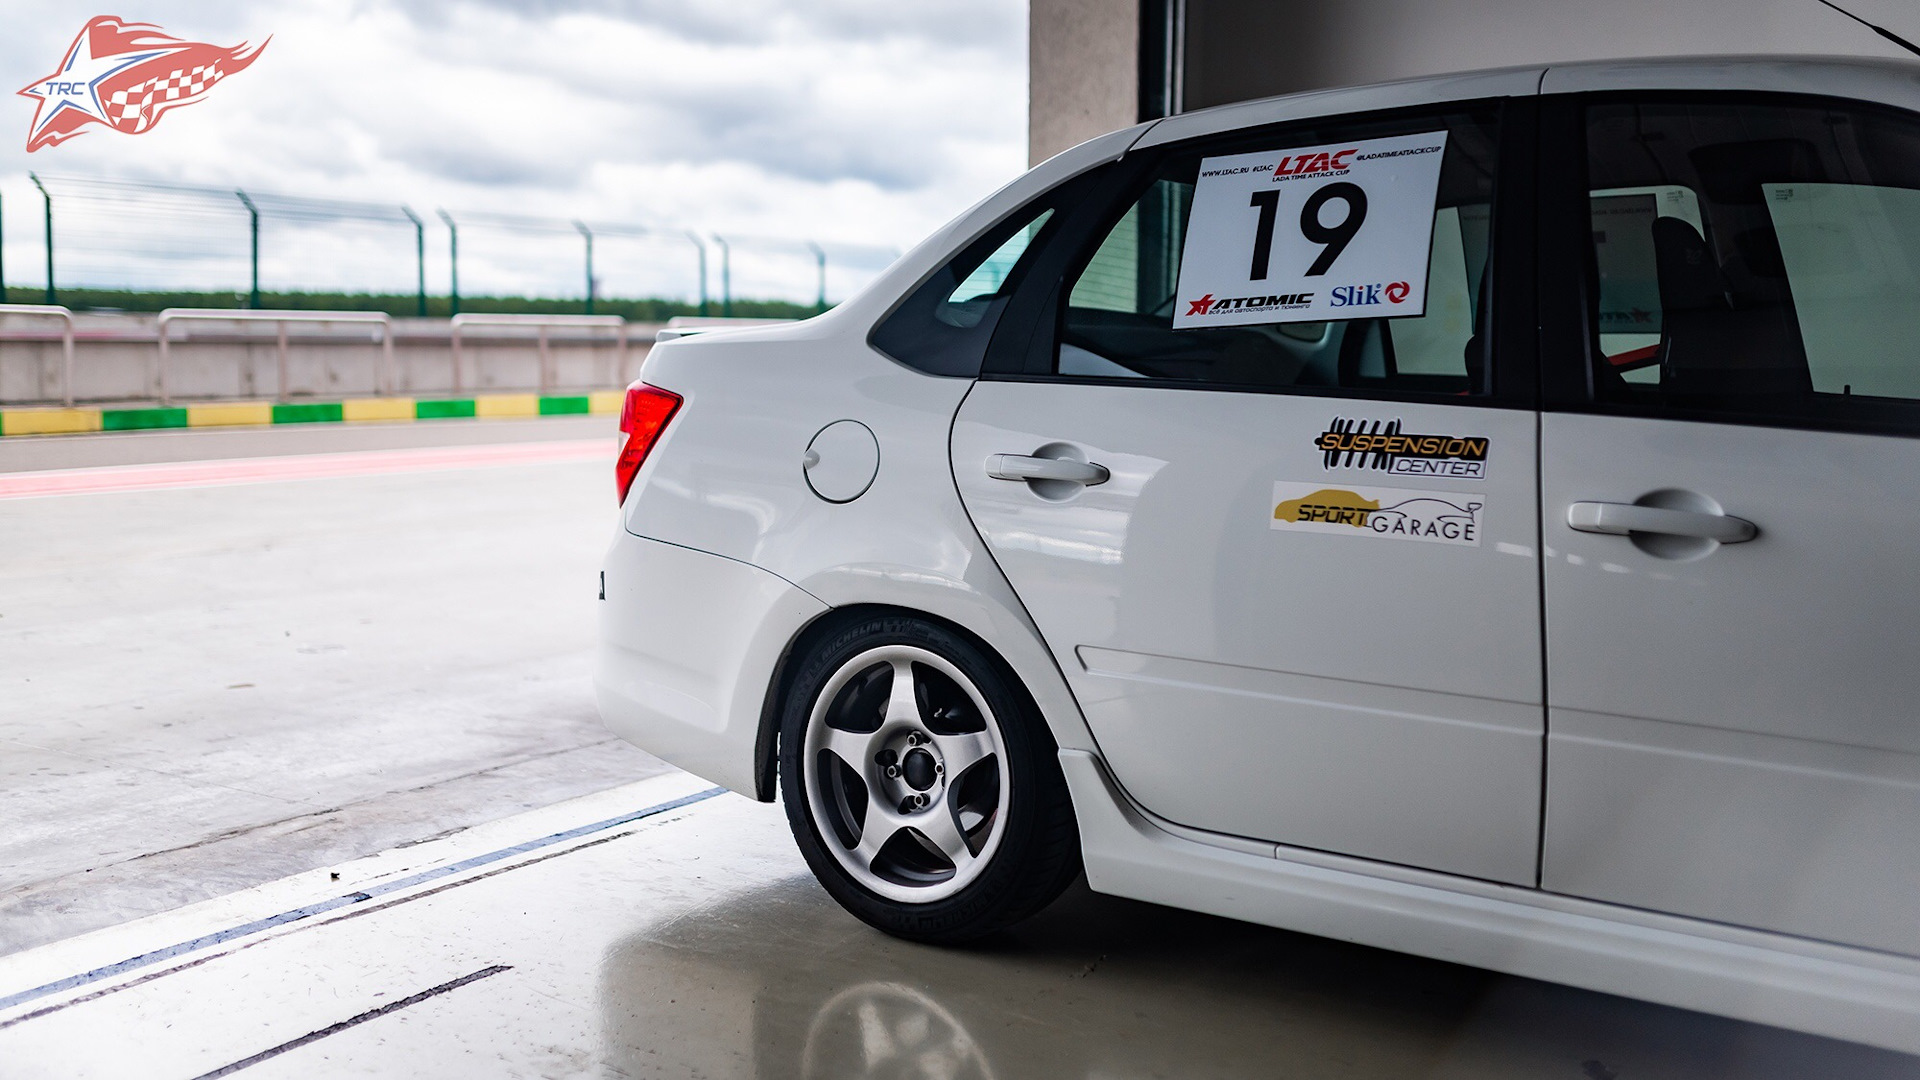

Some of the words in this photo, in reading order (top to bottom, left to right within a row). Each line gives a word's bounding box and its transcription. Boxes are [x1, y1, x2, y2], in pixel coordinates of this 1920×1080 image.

[1273, 149, 1359, 176] LTAC
[1356, 146, 1442, 161] @LADATIMEATTACKCUP
[1202, 167, 1249, 177] WWW.LTAC.RU
[1252, 164, 1274, 172] #LTAC
[1249, 182, 1368, 281] 19
[1212, 293, 1314, 310] ATOMIC
[1321, 433, 1486, 457] SUSPENSION
[1396, 459, 1481, 476] CENTER
[1299, 504, 1376, 526] SPORT
[1372, 516, 1475, 541] GARAGE
[821, 621, 882, 661] MICHELIN
